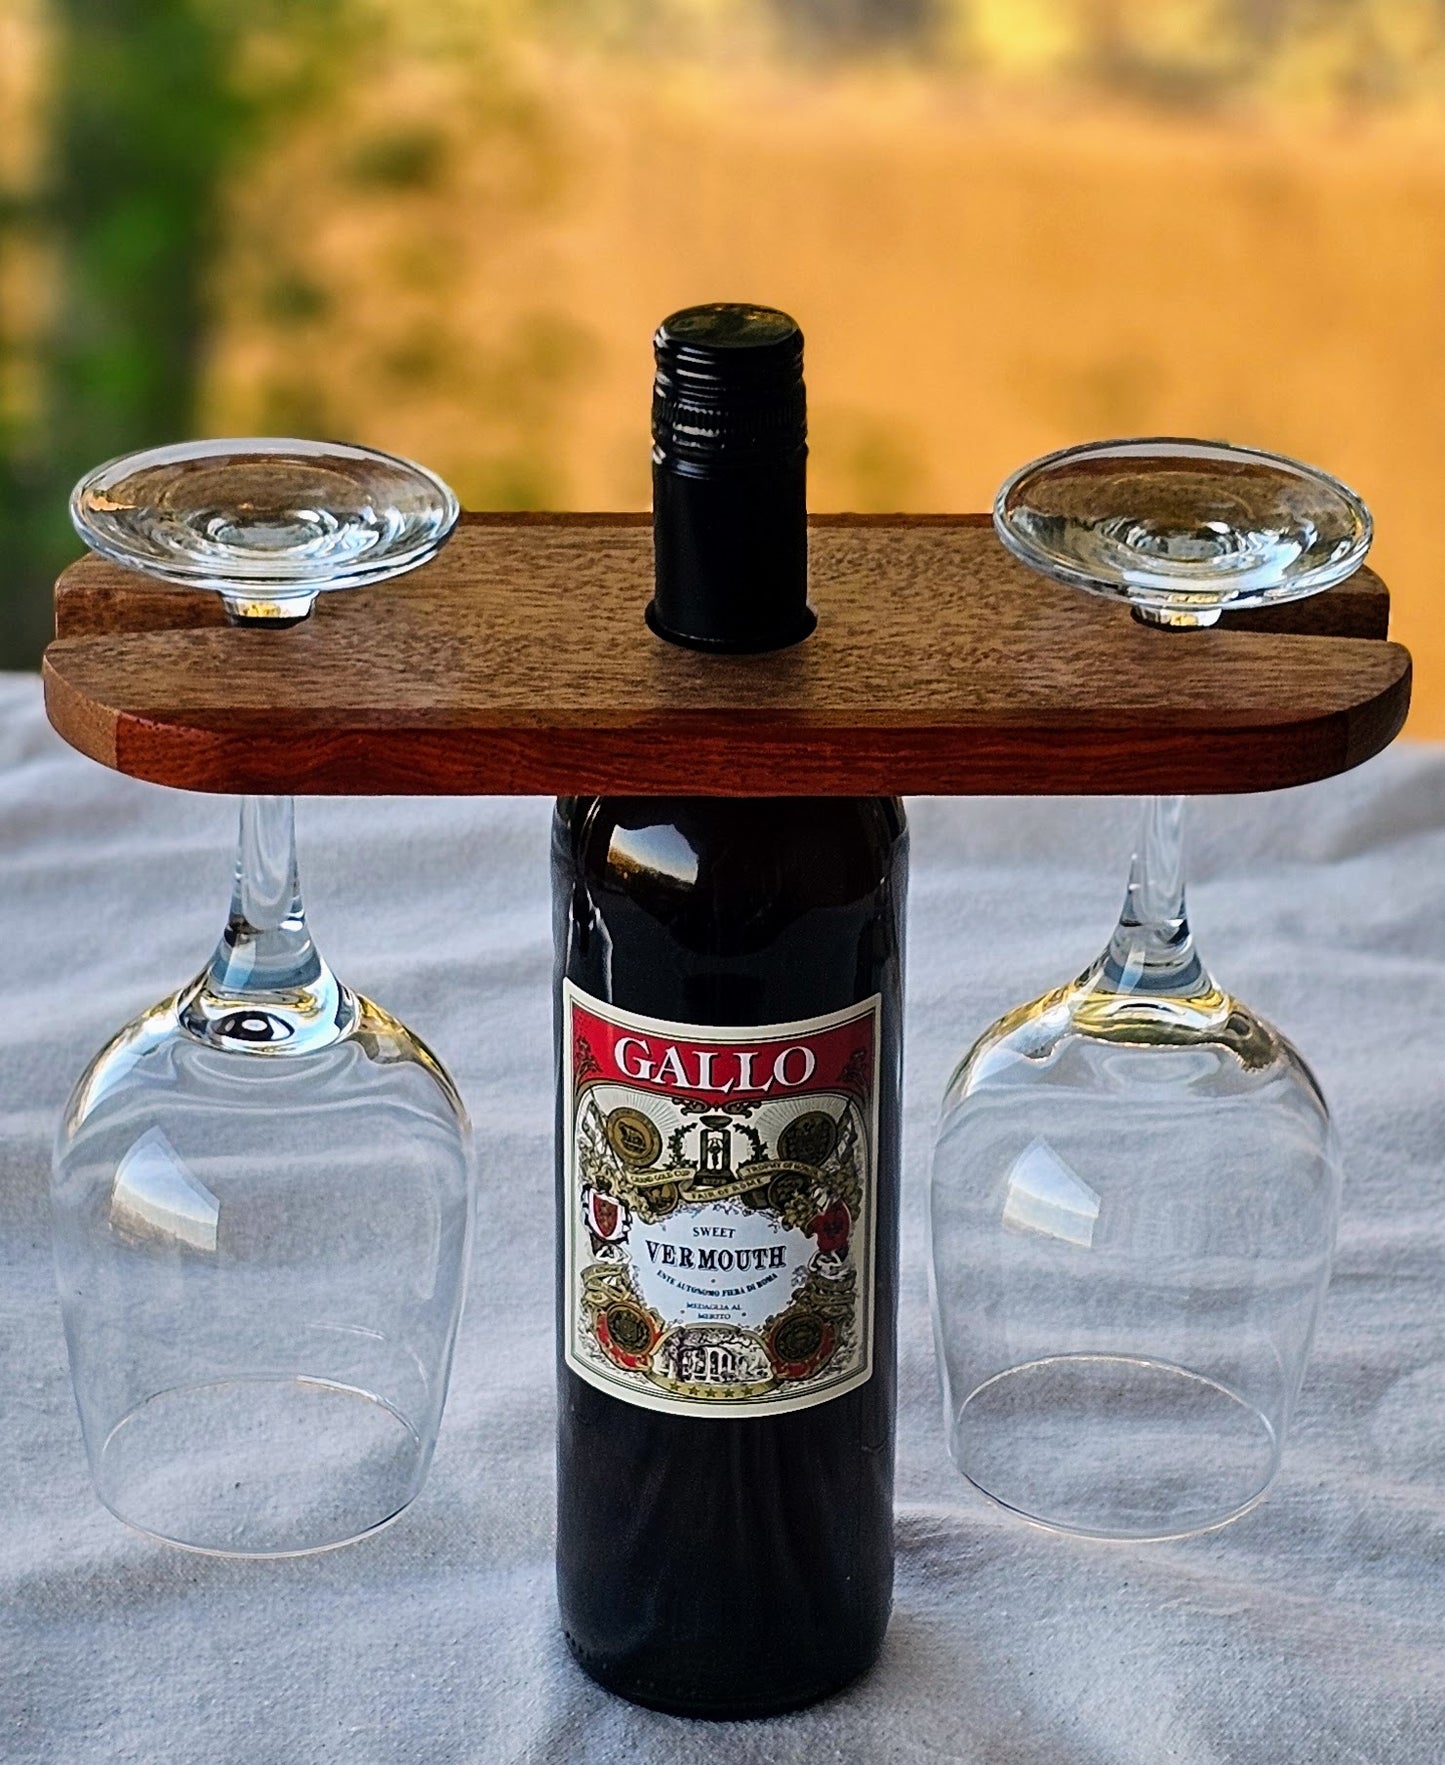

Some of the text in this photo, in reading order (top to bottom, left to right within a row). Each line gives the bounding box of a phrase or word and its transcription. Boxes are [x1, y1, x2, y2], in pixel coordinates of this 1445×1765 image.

[613, 1035, 816, 1092] GALLO
[691, 1189, 716, 1200] FAIR
[717, 1188, 730, 1196] OF
[732, 1178, 761, 1191] ROME
[693, 1226, 737, 1239] SWEET
[645, 1239, 787, 1271] VERMOUTH
[677, 1282, 721, 1297] AUTONOMO
[746, 1284, 757, 1293] DI
[757, 1273, 778, 1288] ROMA
[730, 1303, 743, 1311] AL
